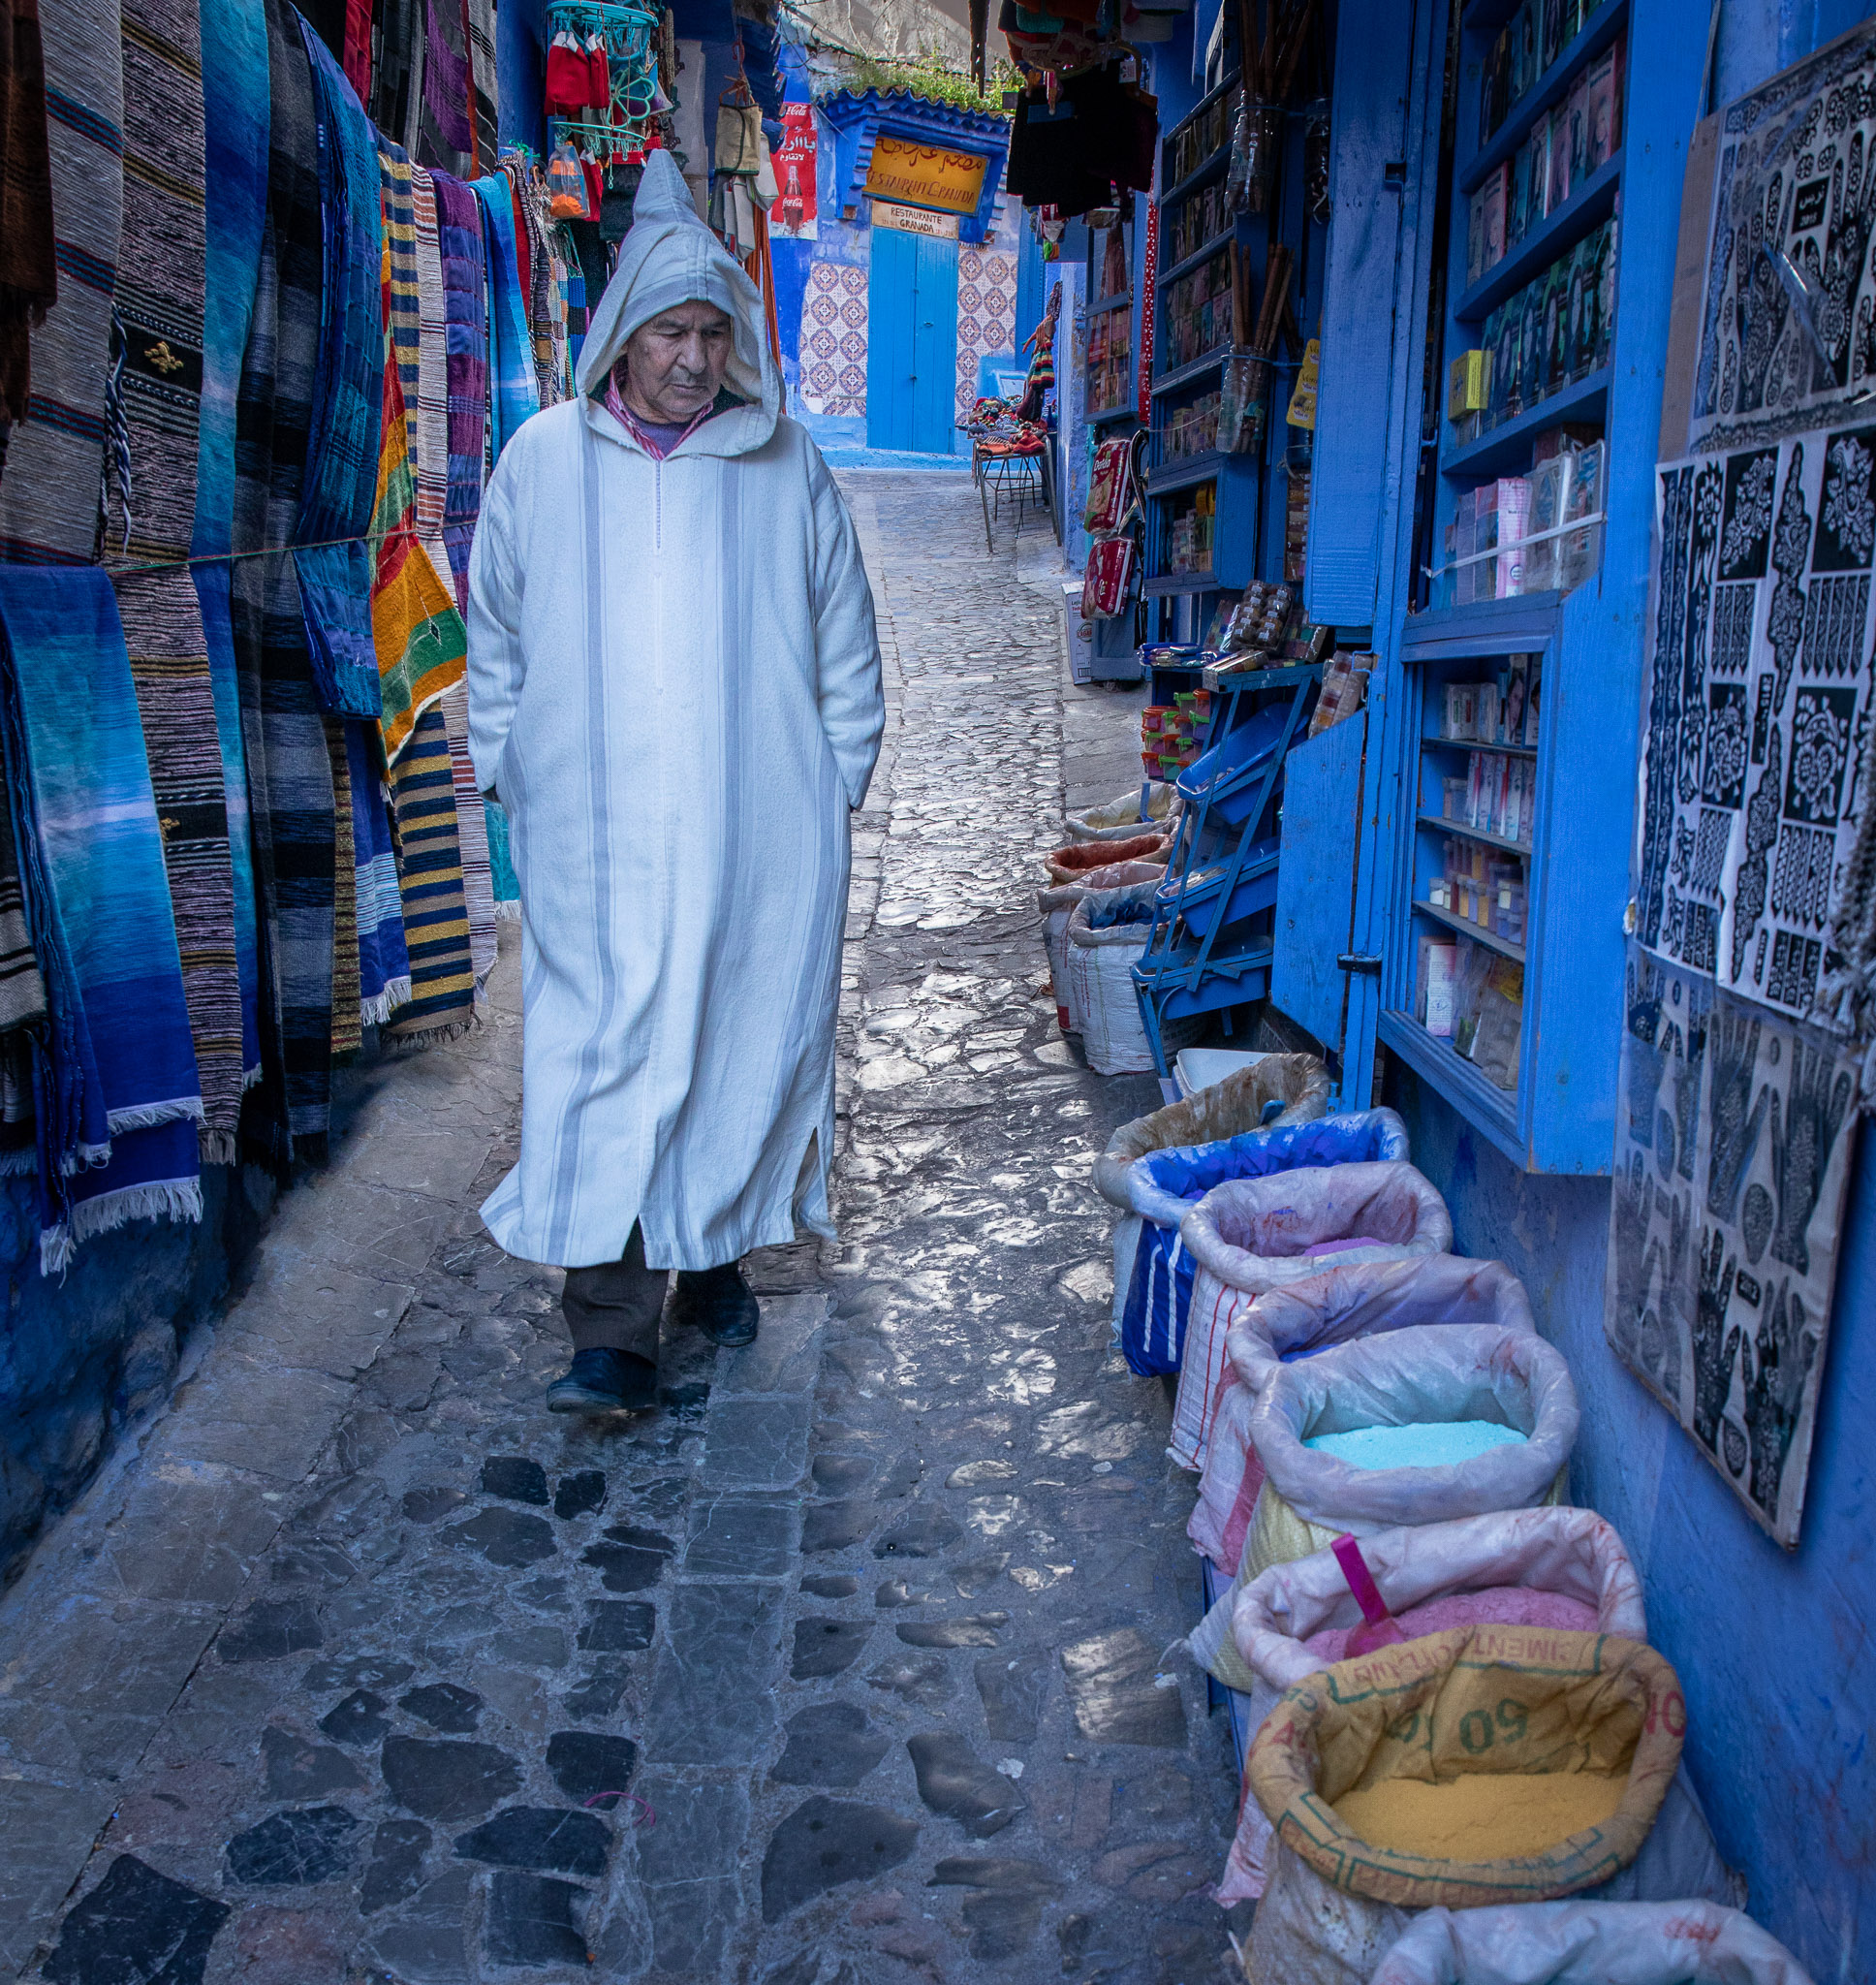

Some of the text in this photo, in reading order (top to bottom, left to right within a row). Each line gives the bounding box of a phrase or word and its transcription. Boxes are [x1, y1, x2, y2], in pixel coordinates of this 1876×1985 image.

[891, 206, 943, 225] RESTAURANTE
[899, 219, 934, 234] GRANADA
[1760, 676, 1772, 708] 2015
